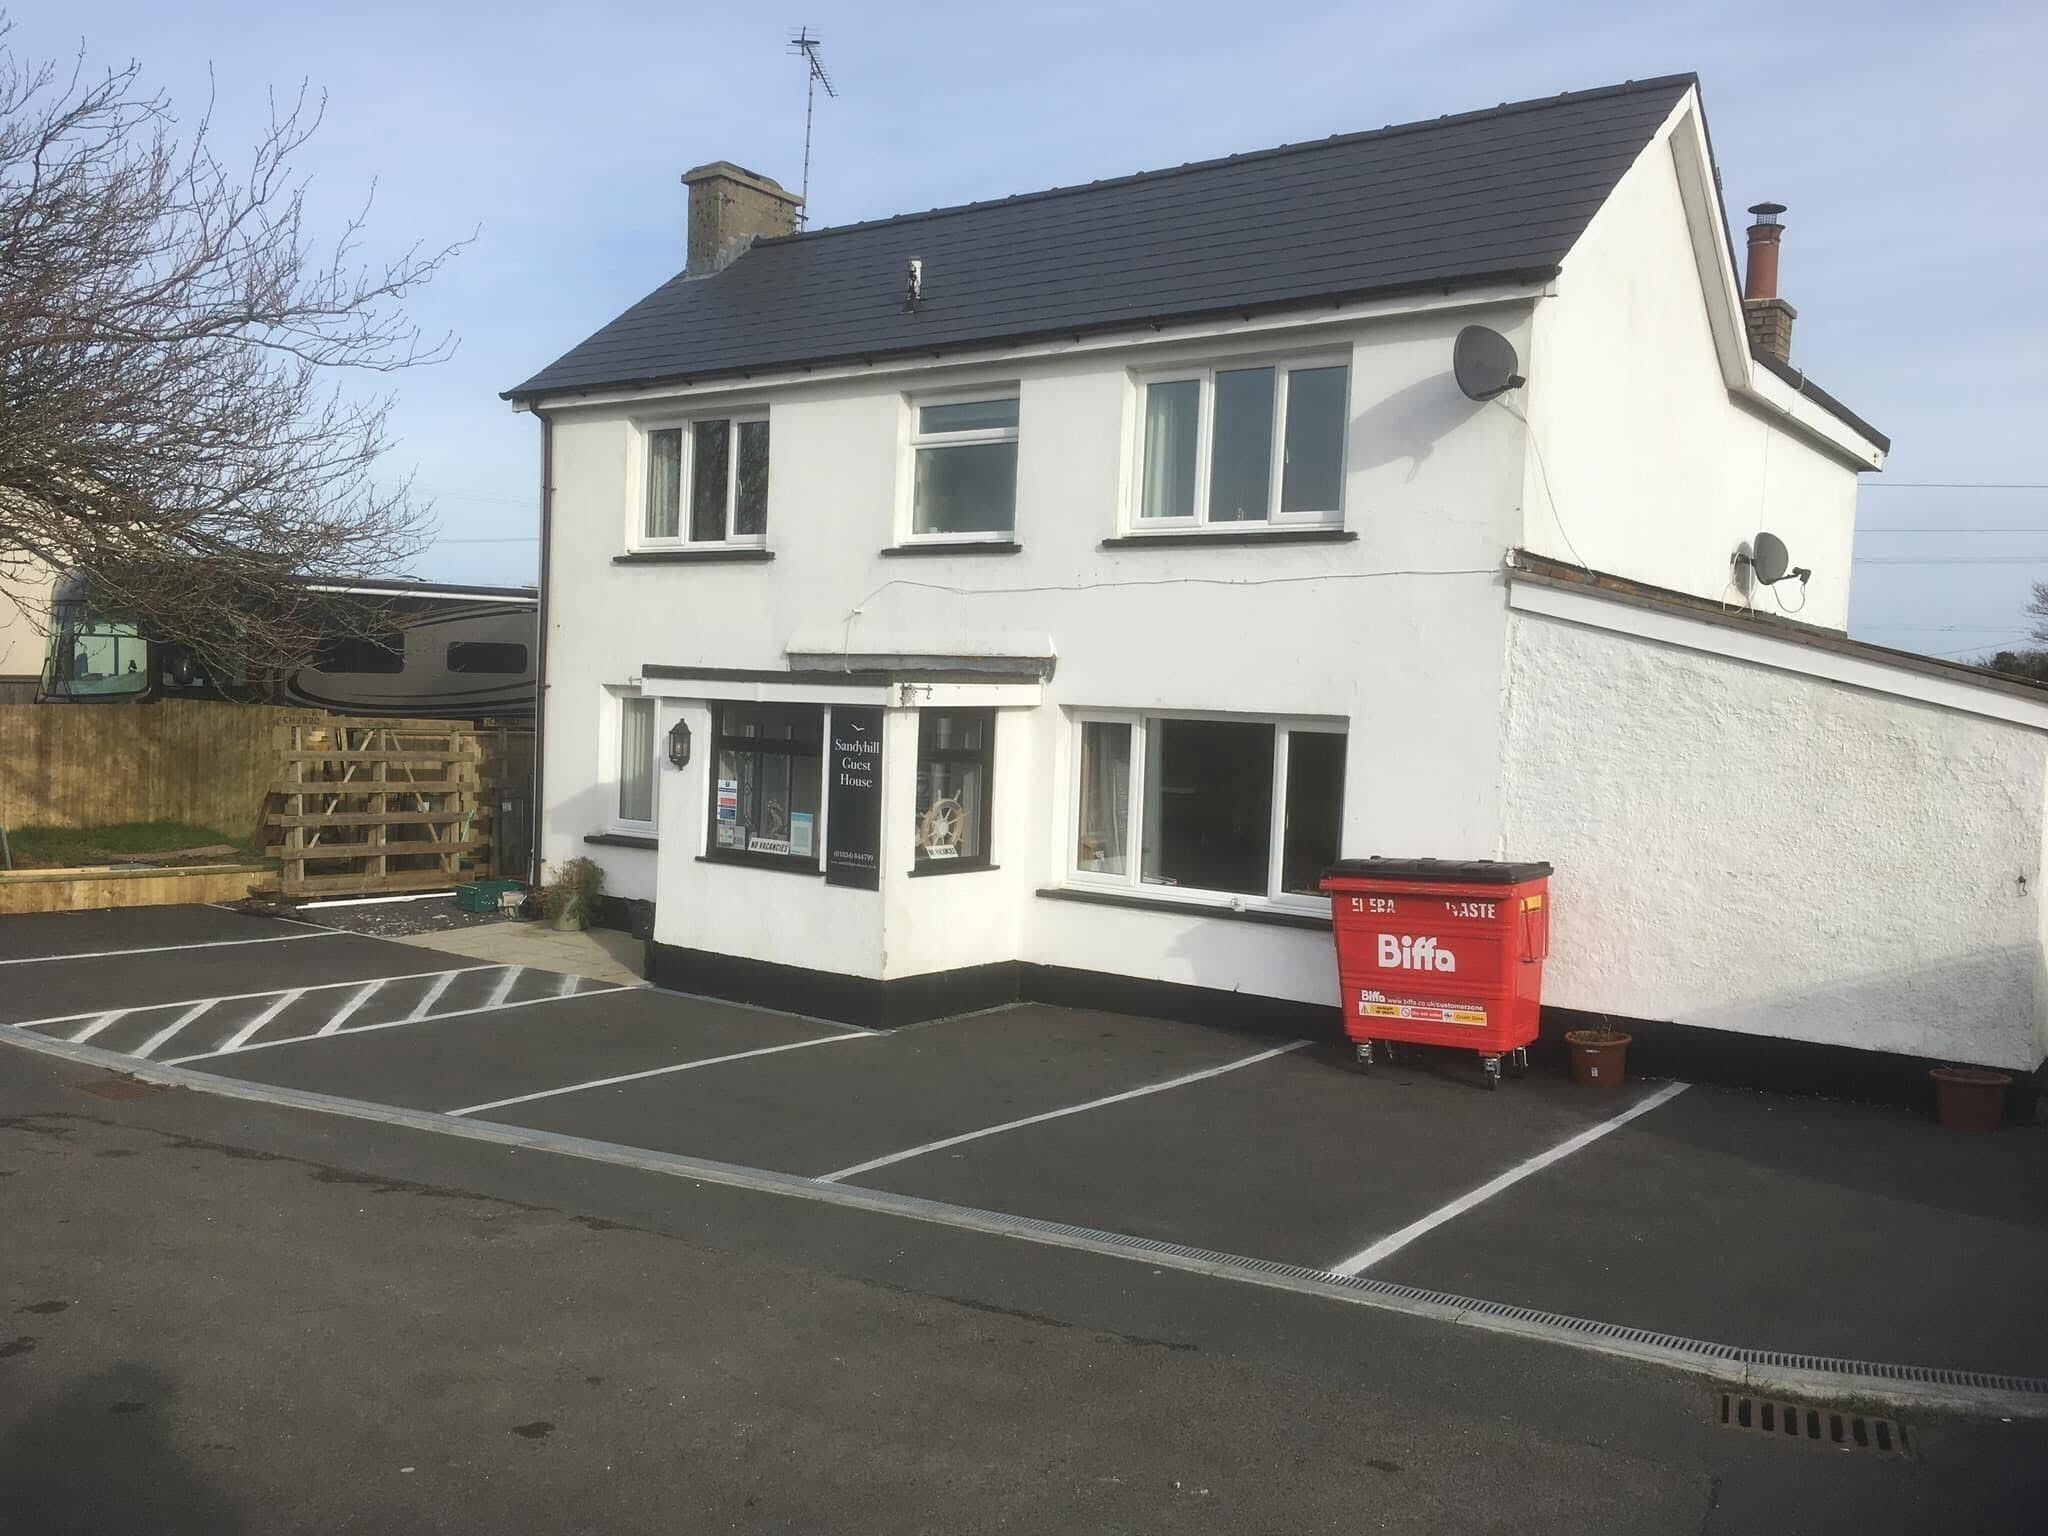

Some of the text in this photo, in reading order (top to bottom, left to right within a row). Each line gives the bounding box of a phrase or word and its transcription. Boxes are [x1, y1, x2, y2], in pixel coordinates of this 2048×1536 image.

[834, 738, 880, 756] Sandyhill
[842, 756, 872, 771] Guest
[840, 773, 873, 788] House
[751, 841, 788, 853] NO VACANCIES
[1378, 934, 1456, 973] Biffa
[1361, 989, 1386, 1003] Biffa
